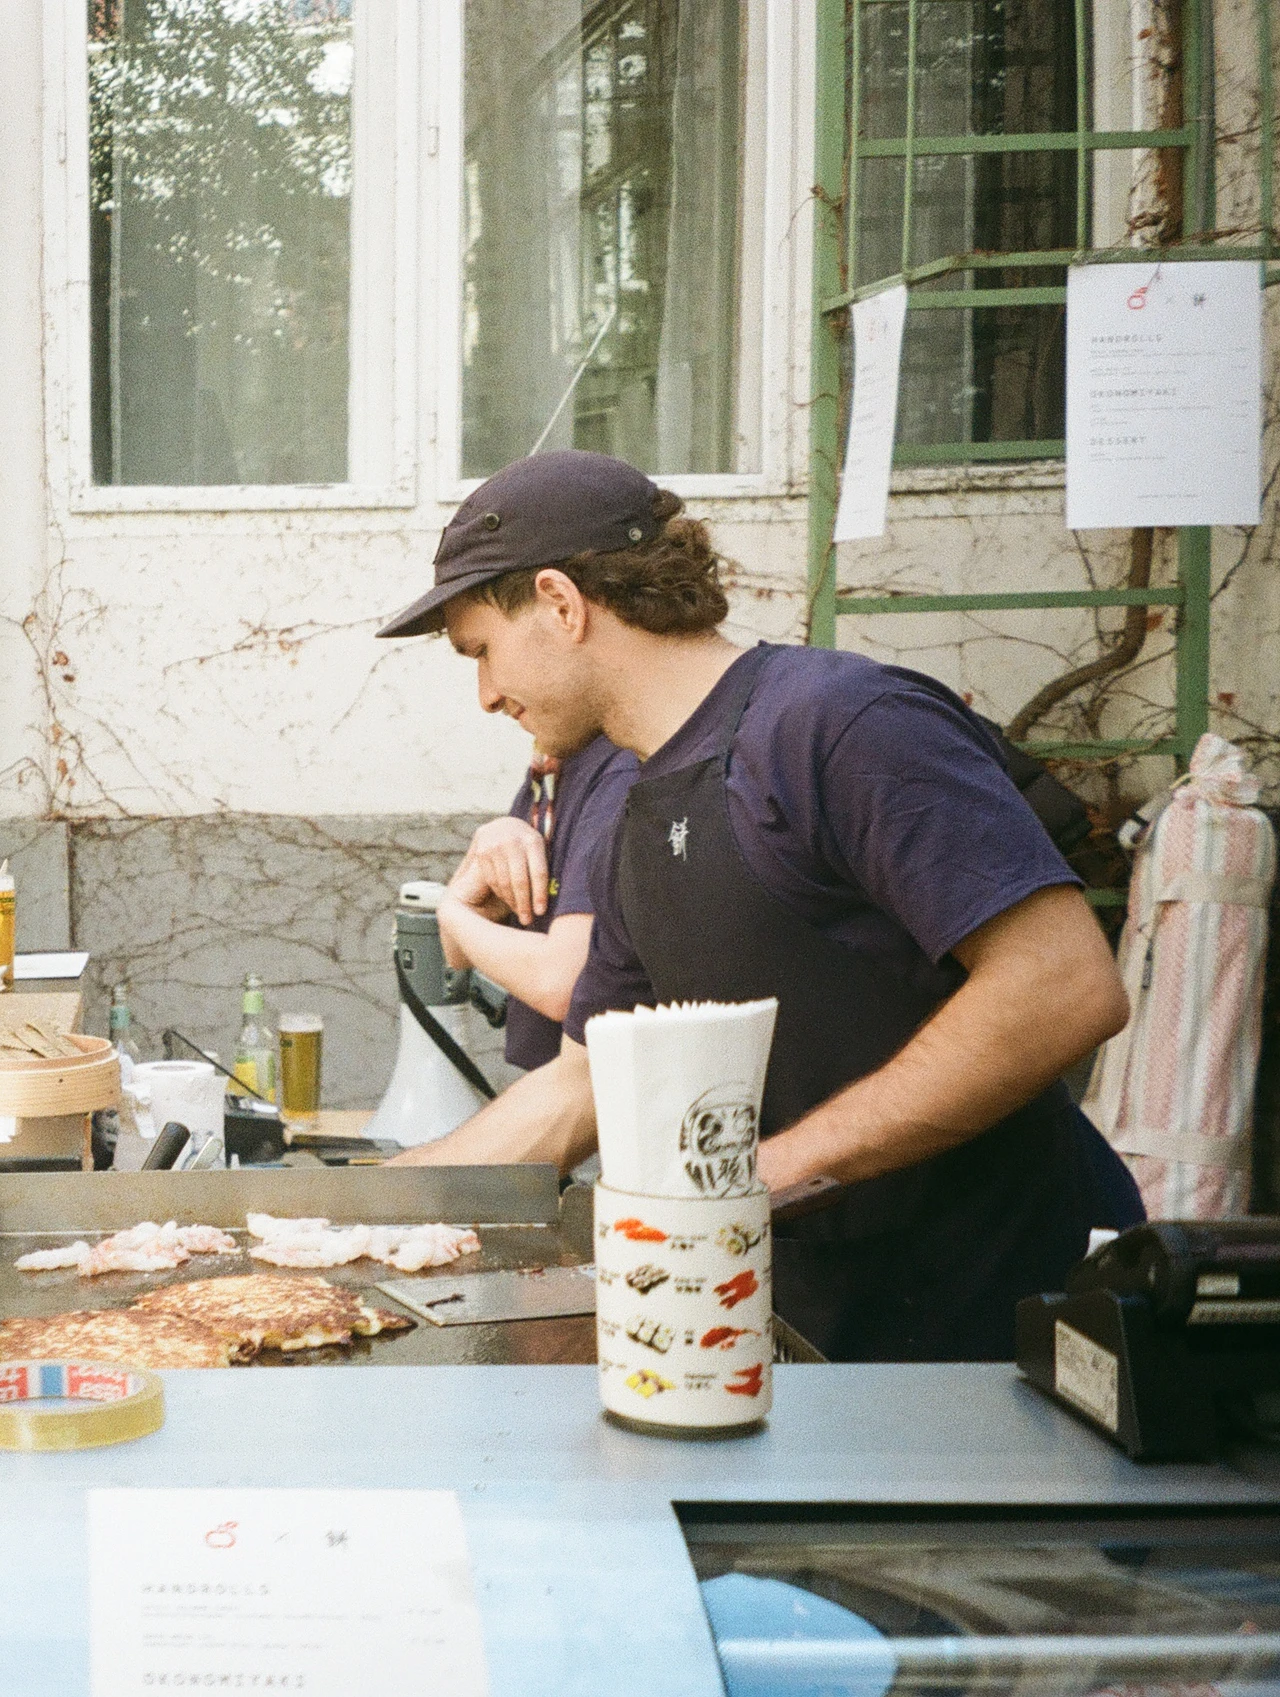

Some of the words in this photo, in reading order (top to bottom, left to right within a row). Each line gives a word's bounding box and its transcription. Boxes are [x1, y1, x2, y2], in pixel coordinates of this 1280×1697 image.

[1090, 388, 1177, 398] OKONOMIYAKI
[1090, 436, 1146, 445] DESSERT
[141, 1672, 307, 1689] OKONOMIYAKI
